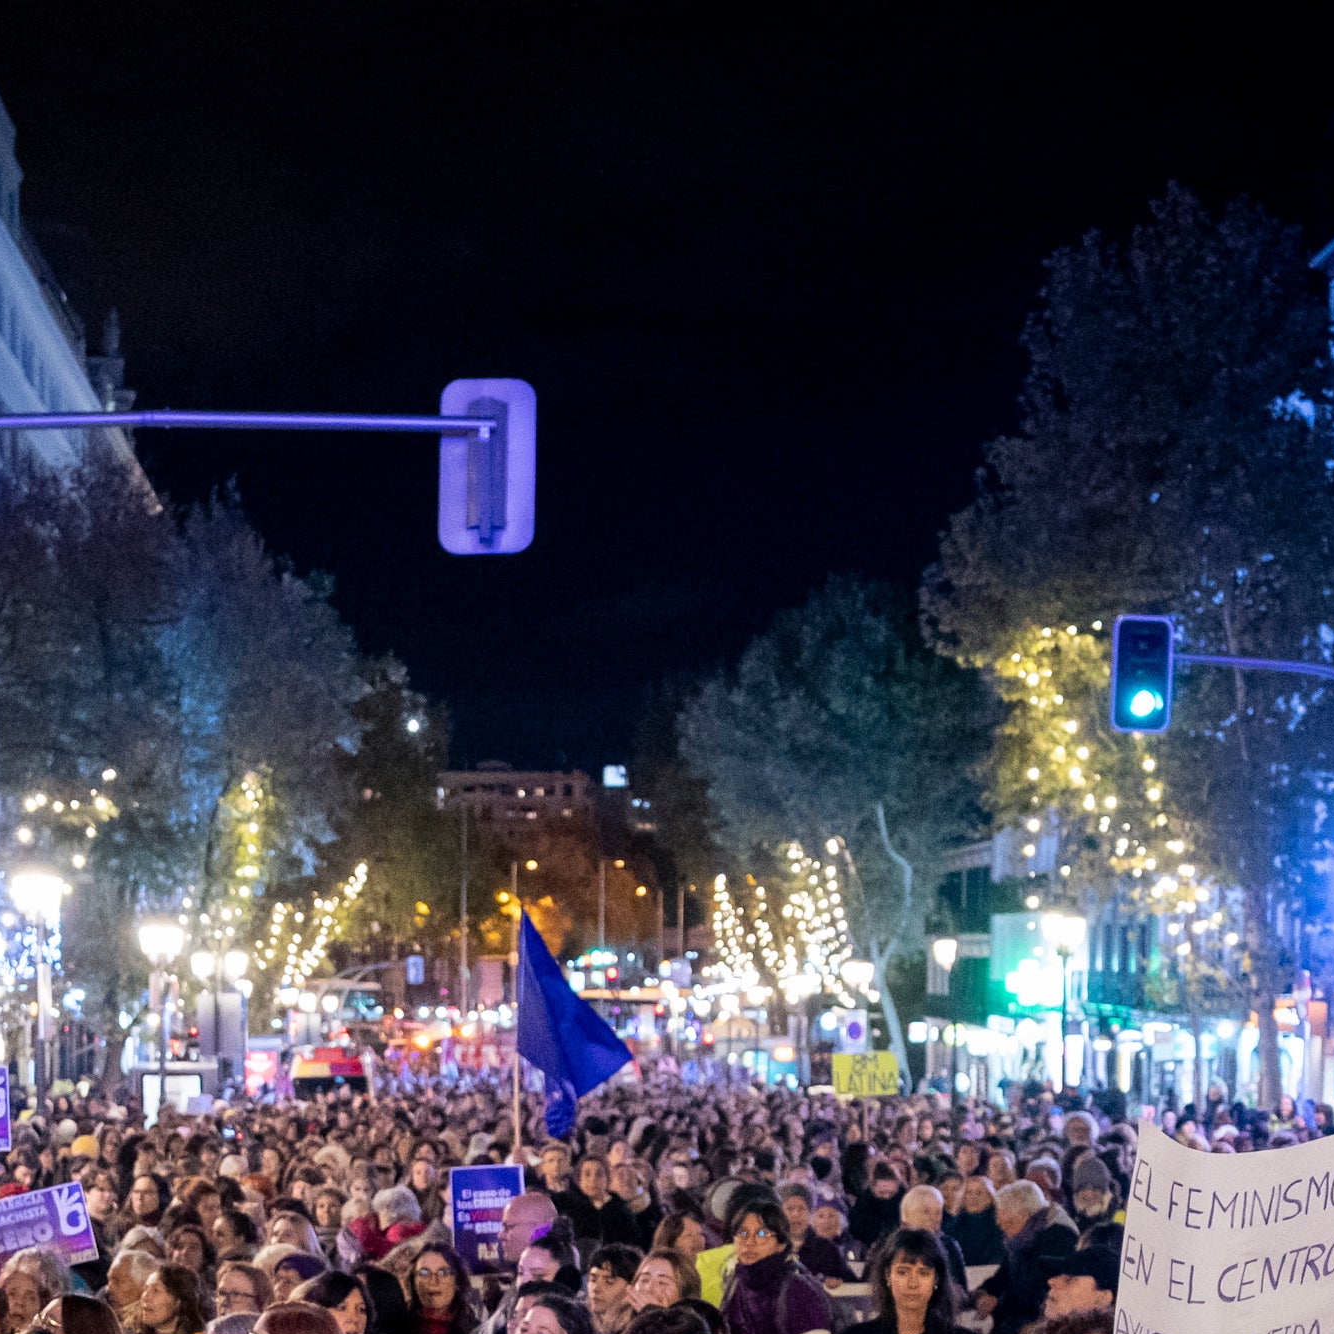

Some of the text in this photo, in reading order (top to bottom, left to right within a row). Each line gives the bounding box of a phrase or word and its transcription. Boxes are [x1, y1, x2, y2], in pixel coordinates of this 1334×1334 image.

[1133, 1159, 1157, 1211] EL
[1123, 1235, 1154, 1285] EN
[1169, 1259, 1205, 1304] EL
